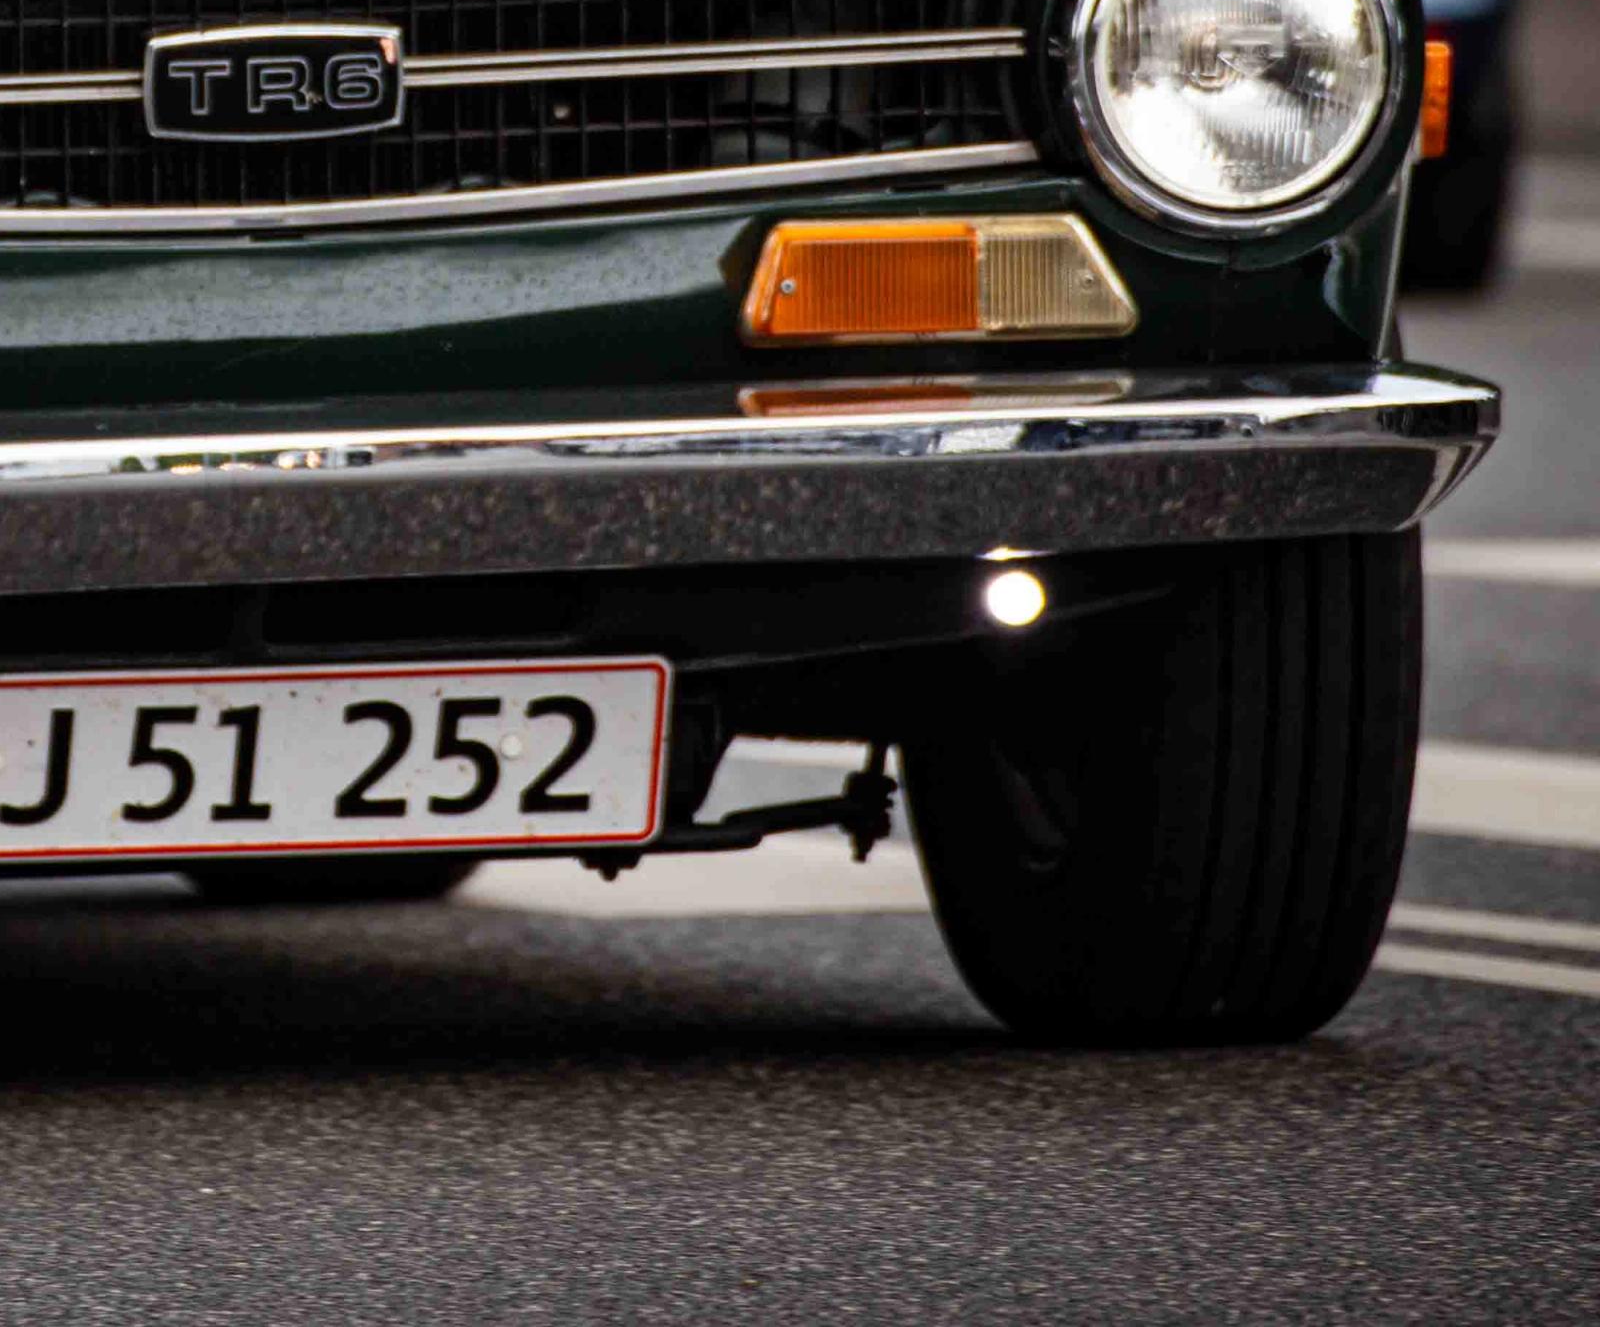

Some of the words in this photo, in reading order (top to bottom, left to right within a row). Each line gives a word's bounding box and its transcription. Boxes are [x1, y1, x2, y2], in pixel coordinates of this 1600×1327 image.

[167, 52, 382, 115] TR6
[121, 704, 272, 824] 51
[334, 695, 597, 819] 252
